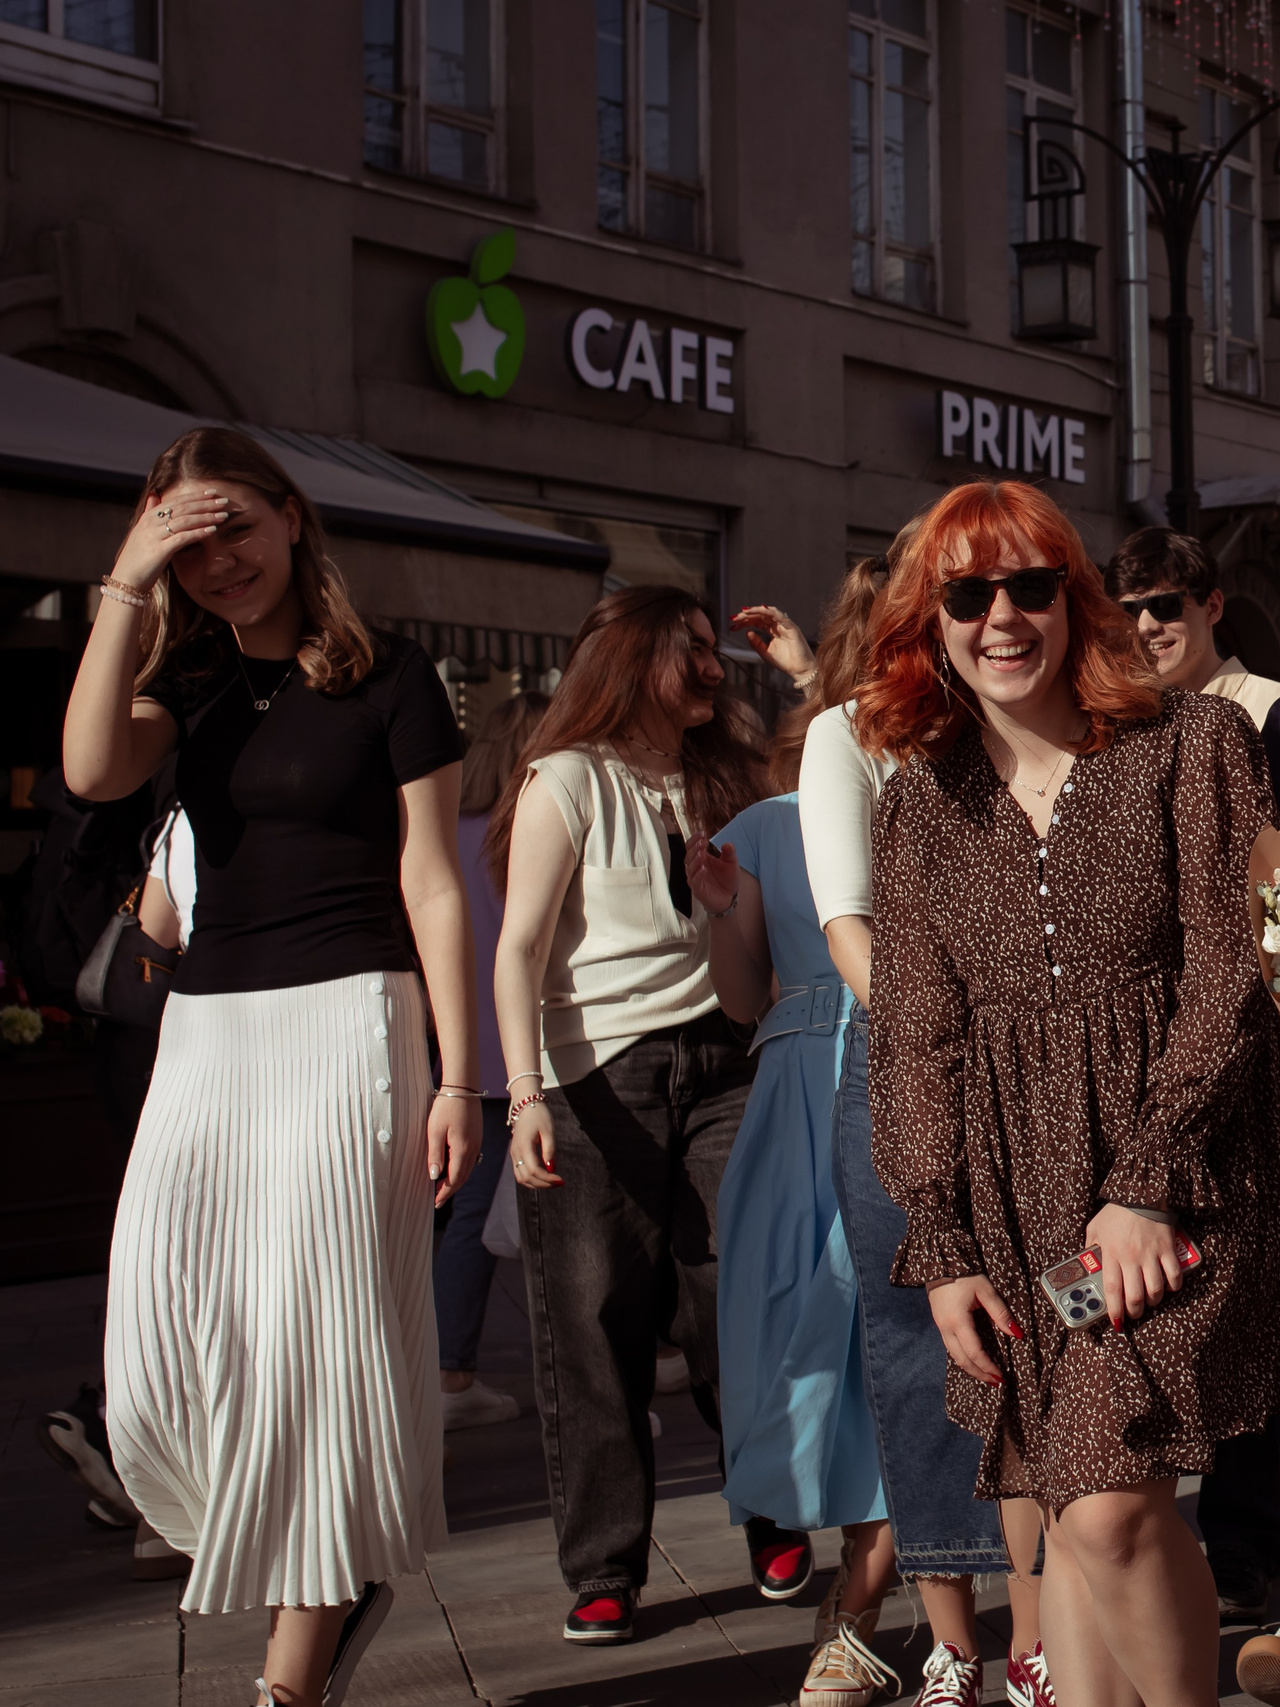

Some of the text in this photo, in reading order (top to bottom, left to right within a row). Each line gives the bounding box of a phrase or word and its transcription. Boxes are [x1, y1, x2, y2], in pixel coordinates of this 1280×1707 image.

[571, 307, 734, 414] CAFE
[941, 390, 1086, 484] PRIME
[1083, 1254, 1098, 1270] KISS
